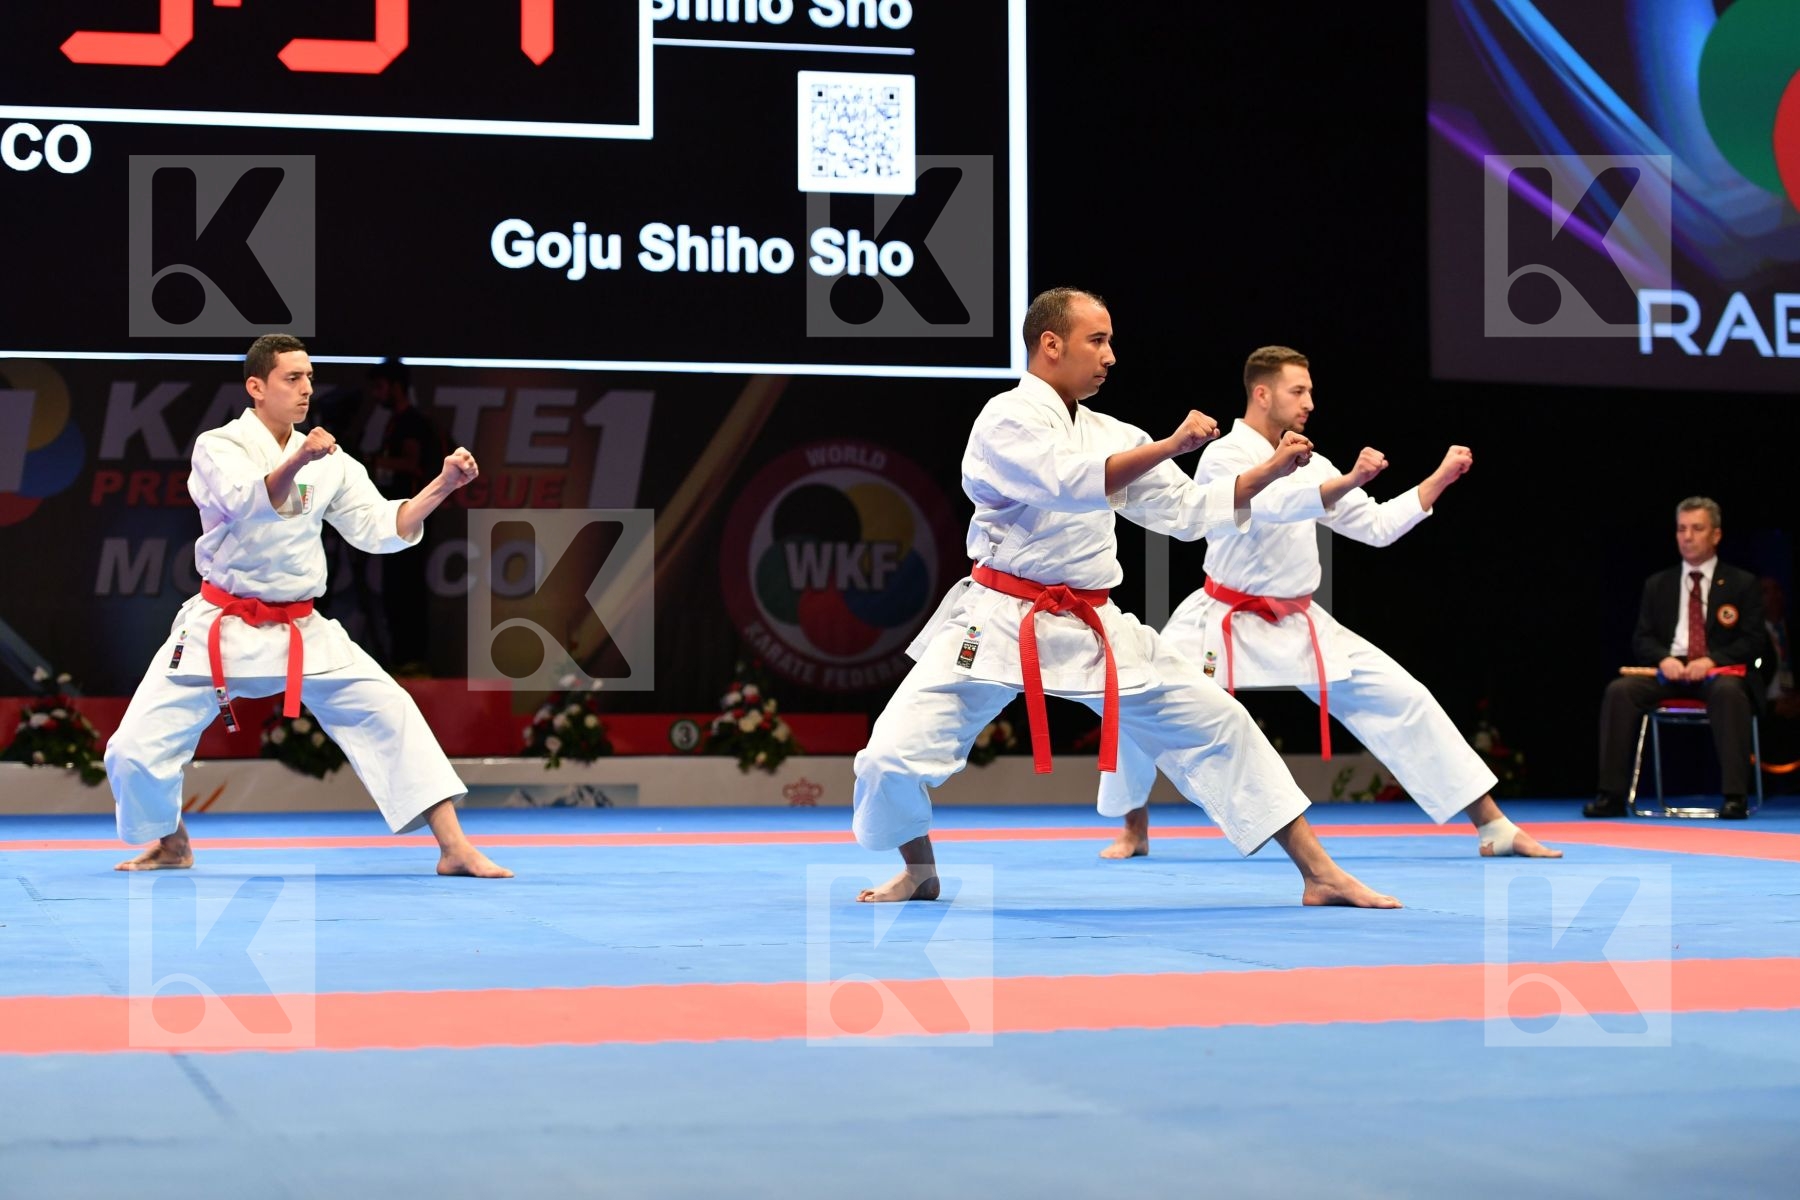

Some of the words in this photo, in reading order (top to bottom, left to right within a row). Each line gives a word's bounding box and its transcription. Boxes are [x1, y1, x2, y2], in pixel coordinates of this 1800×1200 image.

[490, 218, 622, 281] Goju
[637, 222, 795, 274] Shiho
[808, 227, 914, 277] Sho
[804, 444, 888, 471] WORLD
[783, 541, 900, 592] WKF
